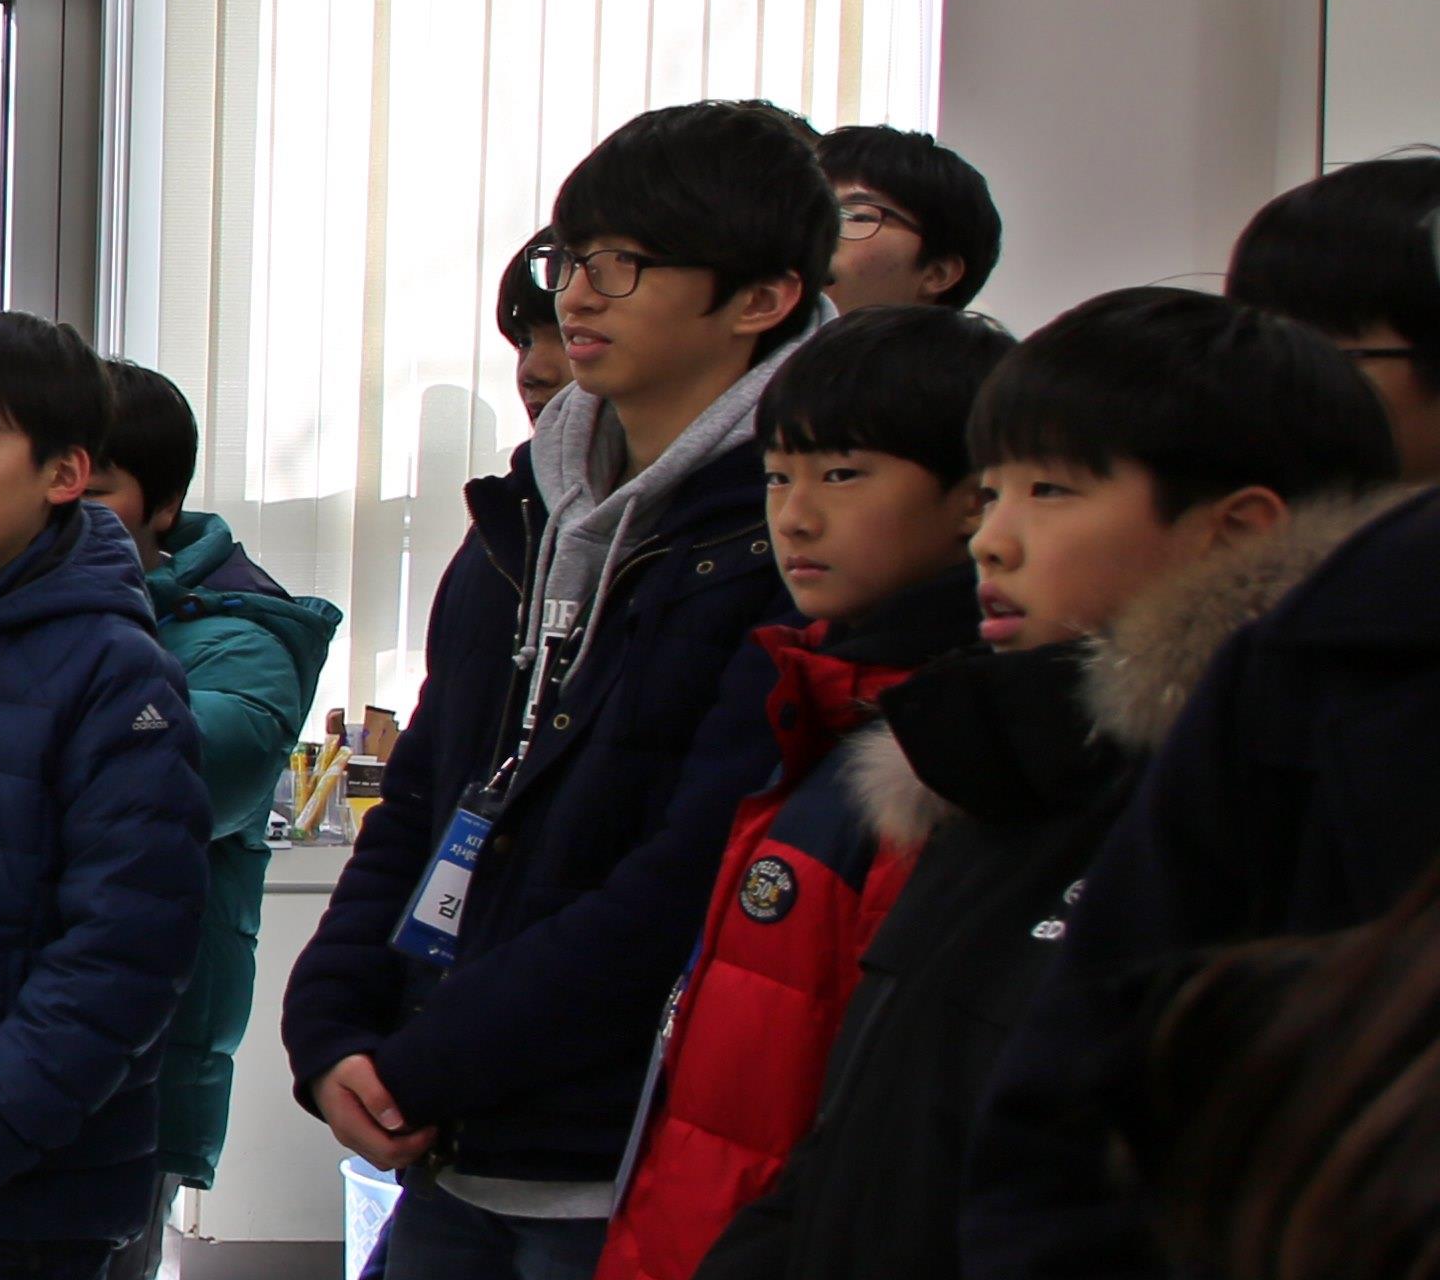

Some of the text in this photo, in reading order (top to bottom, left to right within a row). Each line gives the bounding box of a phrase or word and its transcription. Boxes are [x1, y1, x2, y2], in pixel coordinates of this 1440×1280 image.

[132, 720, 169, 730] adidas
[464, 833, 484, 850] KIT
[438, 893, 463, 920] 김
